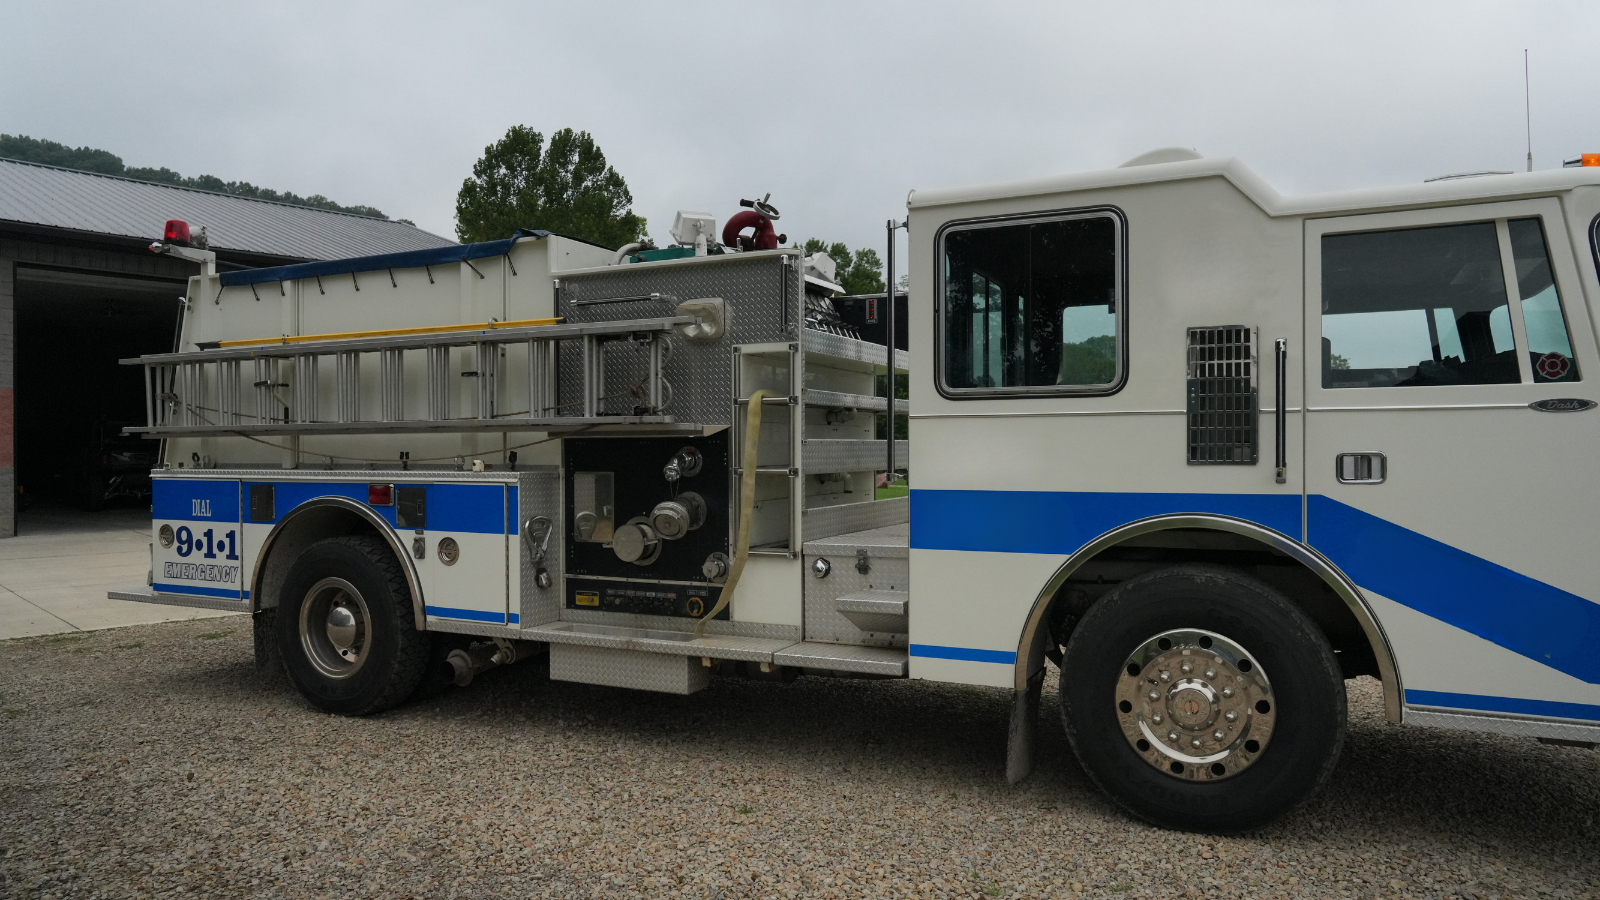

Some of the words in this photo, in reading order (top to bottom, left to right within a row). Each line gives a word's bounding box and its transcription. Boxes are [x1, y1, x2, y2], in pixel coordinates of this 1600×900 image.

[1547, 400, 1580, 409] Dash
[192, 499, 212, 517] DIAL
[164, 562, 239, 583] EMERGENCY
